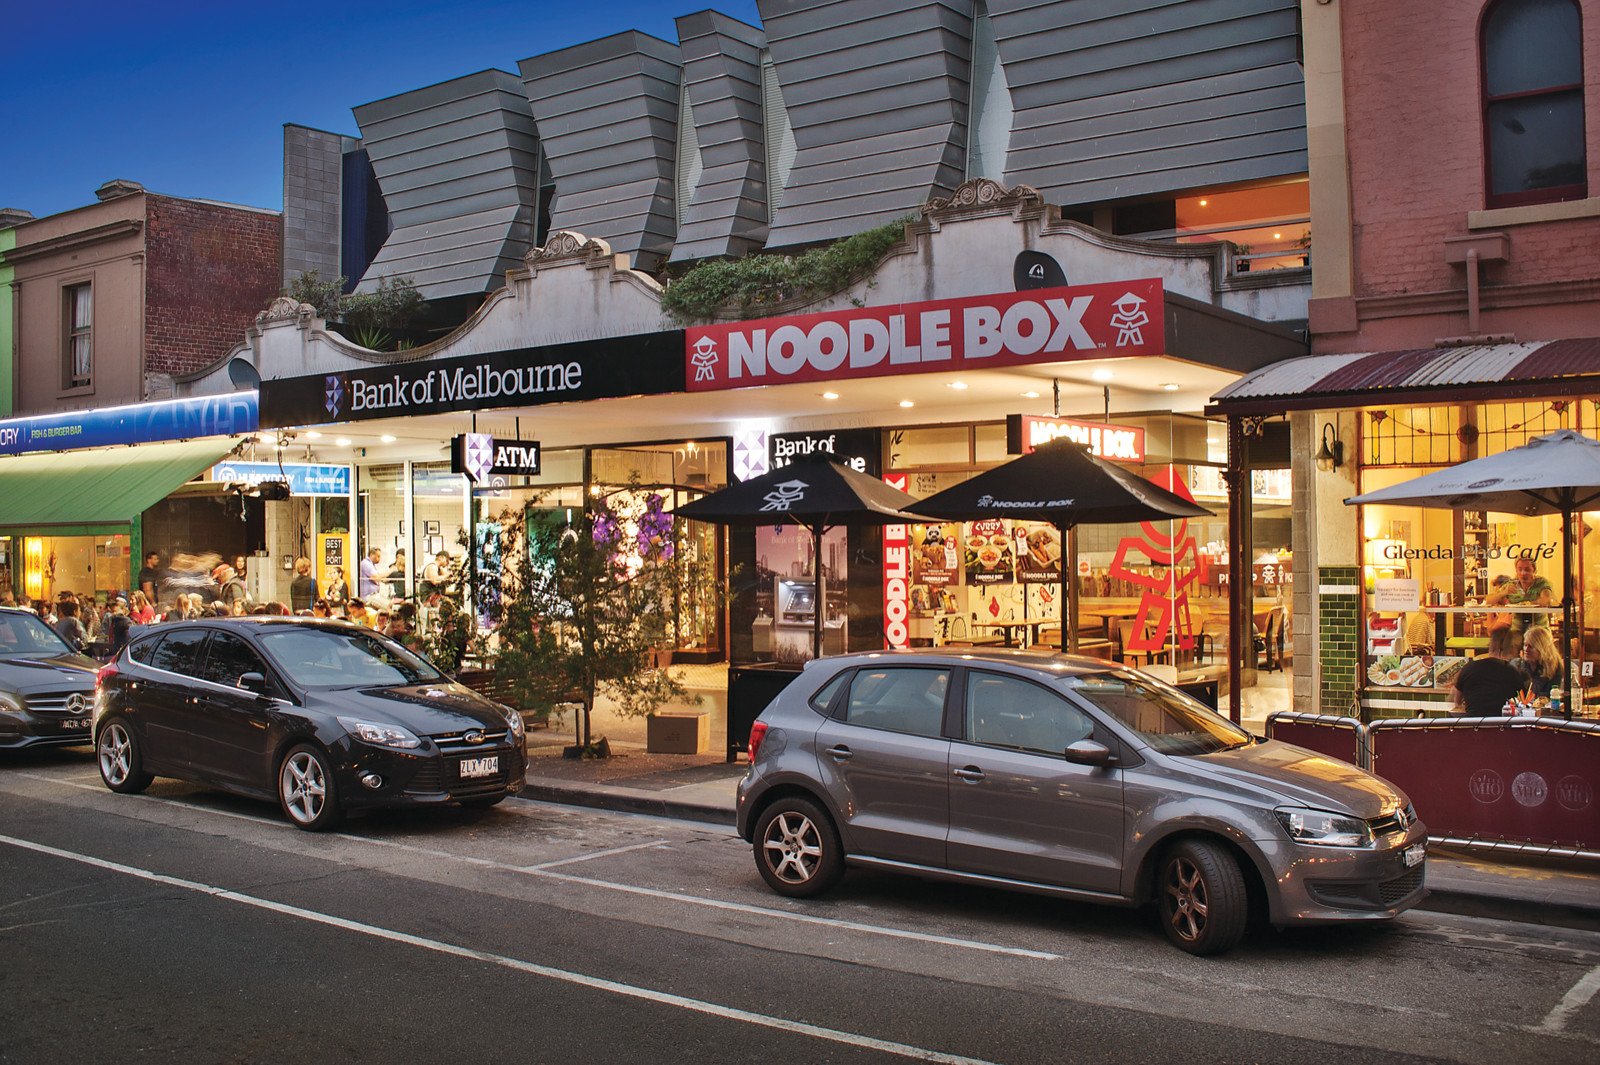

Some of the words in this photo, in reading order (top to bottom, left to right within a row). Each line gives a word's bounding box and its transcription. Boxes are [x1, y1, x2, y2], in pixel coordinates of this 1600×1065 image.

[728, 309, 952, 378] NOODLE
[964, 295, 1096, 360] BOX
[351, 375, 409, 411] Bank
[411, 370, 435, 405] of
[439, 361, 582, 402] Melbourne
[48, 426, 70, 437] BURGER
[70, 425, 82, 435] BAR
[775, 437, 816, 457] Bank
[818, 435, 835, 454] of
[495, 446, 536, 468] ATM
[992, 500, 1046, 508] NOODLE
[1046, 499, 1074, 507] BOX
[975, 521, 1001, 532] CURRY
[326, 539, 342, 549] BEST
[1384, 544, 1453, 560] Glenda
[1506, 542, 1557, 562] Café
[326, 556, 342, 564] PORT
[1479, 569, 1488, 578] 10
[886, 546, 907, 650] OODLE
[1585, 664, 1591, 674] 2
[461, 761, 477, 773] ZLX
[482, 758, 497, 771] 704
